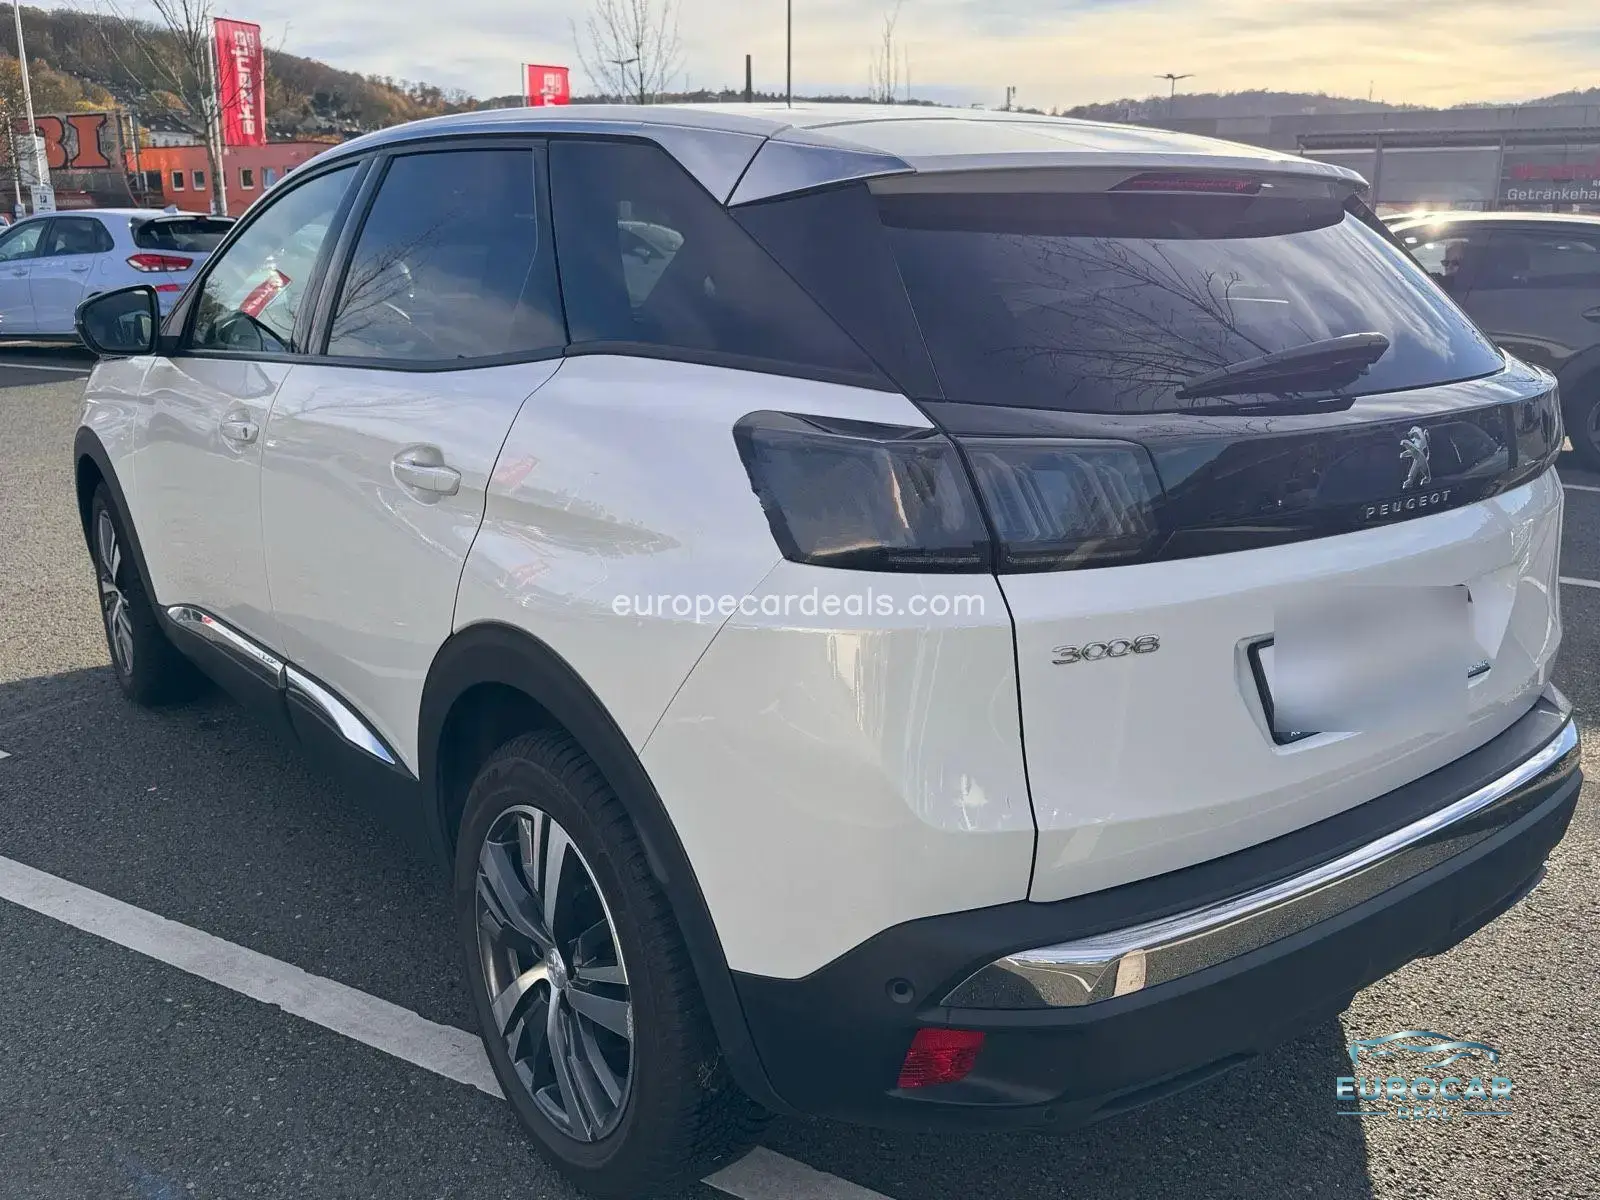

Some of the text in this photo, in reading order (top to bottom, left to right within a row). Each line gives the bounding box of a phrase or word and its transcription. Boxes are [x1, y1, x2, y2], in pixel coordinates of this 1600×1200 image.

[1507, 187, 1600, 201] Getränkeha
[1366, 490, 1451, 519] PEUGEOT
[1051, 633, 1160, 665] 3008
